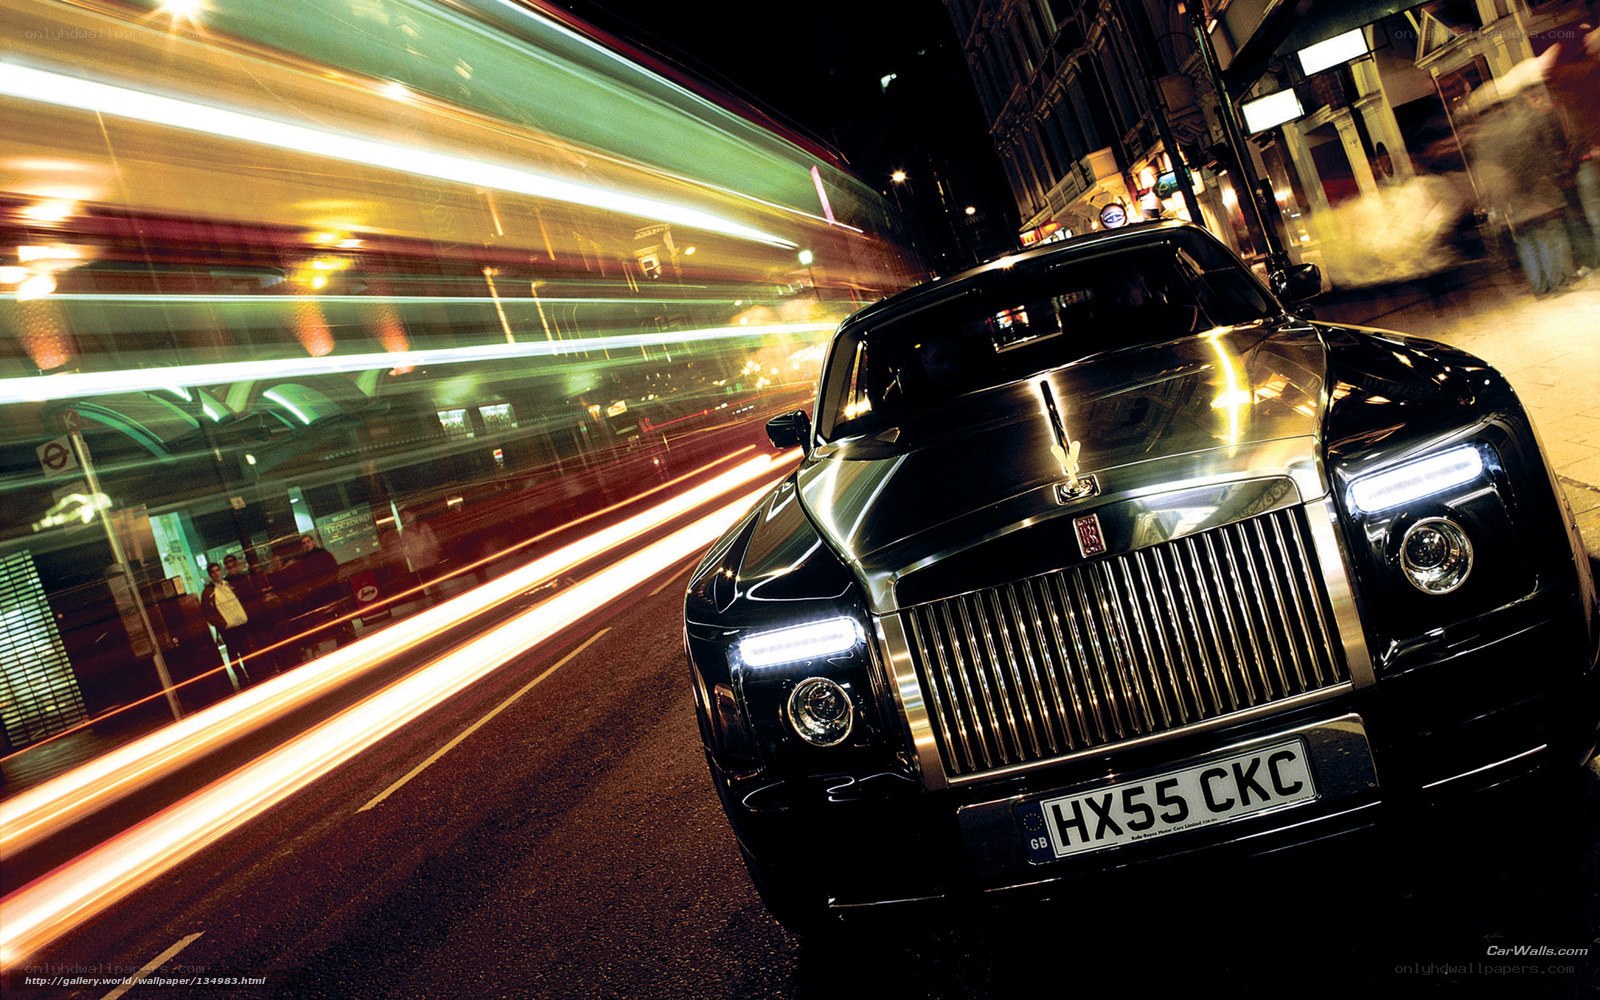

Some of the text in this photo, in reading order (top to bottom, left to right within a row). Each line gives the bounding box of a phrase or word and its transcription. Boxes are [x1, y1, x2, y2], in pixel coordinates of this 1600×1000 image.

[63, 411, 77, 429] K
[1051, 750, 1303, 847] HX55 CKC
[1030, 837, 1048, 850] GB
